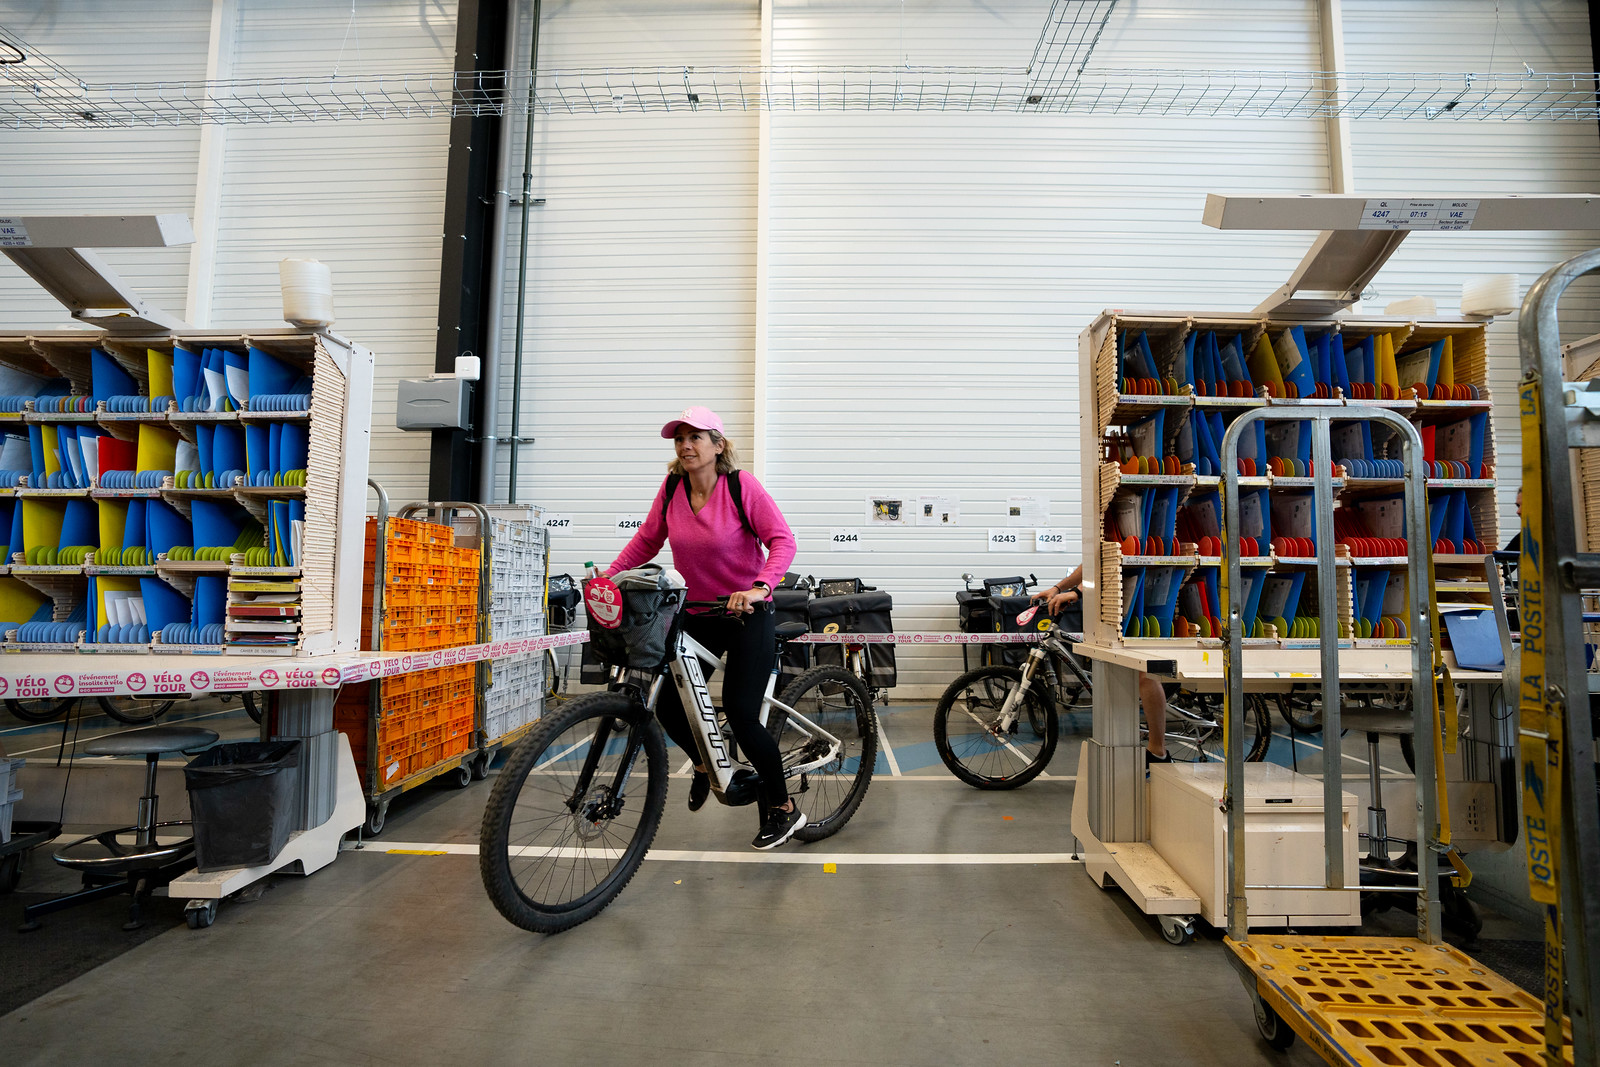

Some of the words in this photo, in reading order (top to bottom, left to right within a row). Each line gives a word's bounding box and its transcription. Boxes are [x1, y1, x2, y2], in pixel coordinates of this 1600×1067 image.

[1521, 390, 1536, 416] LA
[992, 534, 1016, 542] 4243
[1038, 534, 1062, 542] 4242
[1523, 579, 1541, 654] POSTE
[153, 671, 182, 682] VÉLO
[286, 668, 314, 678] VÉLO
[384, 667, 400, 676] TOUR
[16, 675, 46, 687] VÉLO
[286, 680, 317, 688] TOUR
[16, 688, 49, 697] TOUR
[153, 684, 186, 692] TOUR
[1523, 675, 1541, 704] LA
[1548, 739, 1560, 770] LA
[1526, 816, 1551, 883] OSTE
[1546, 942, 1559, 1026] POSTE
[1546, 1043, 1559, 1058] A
